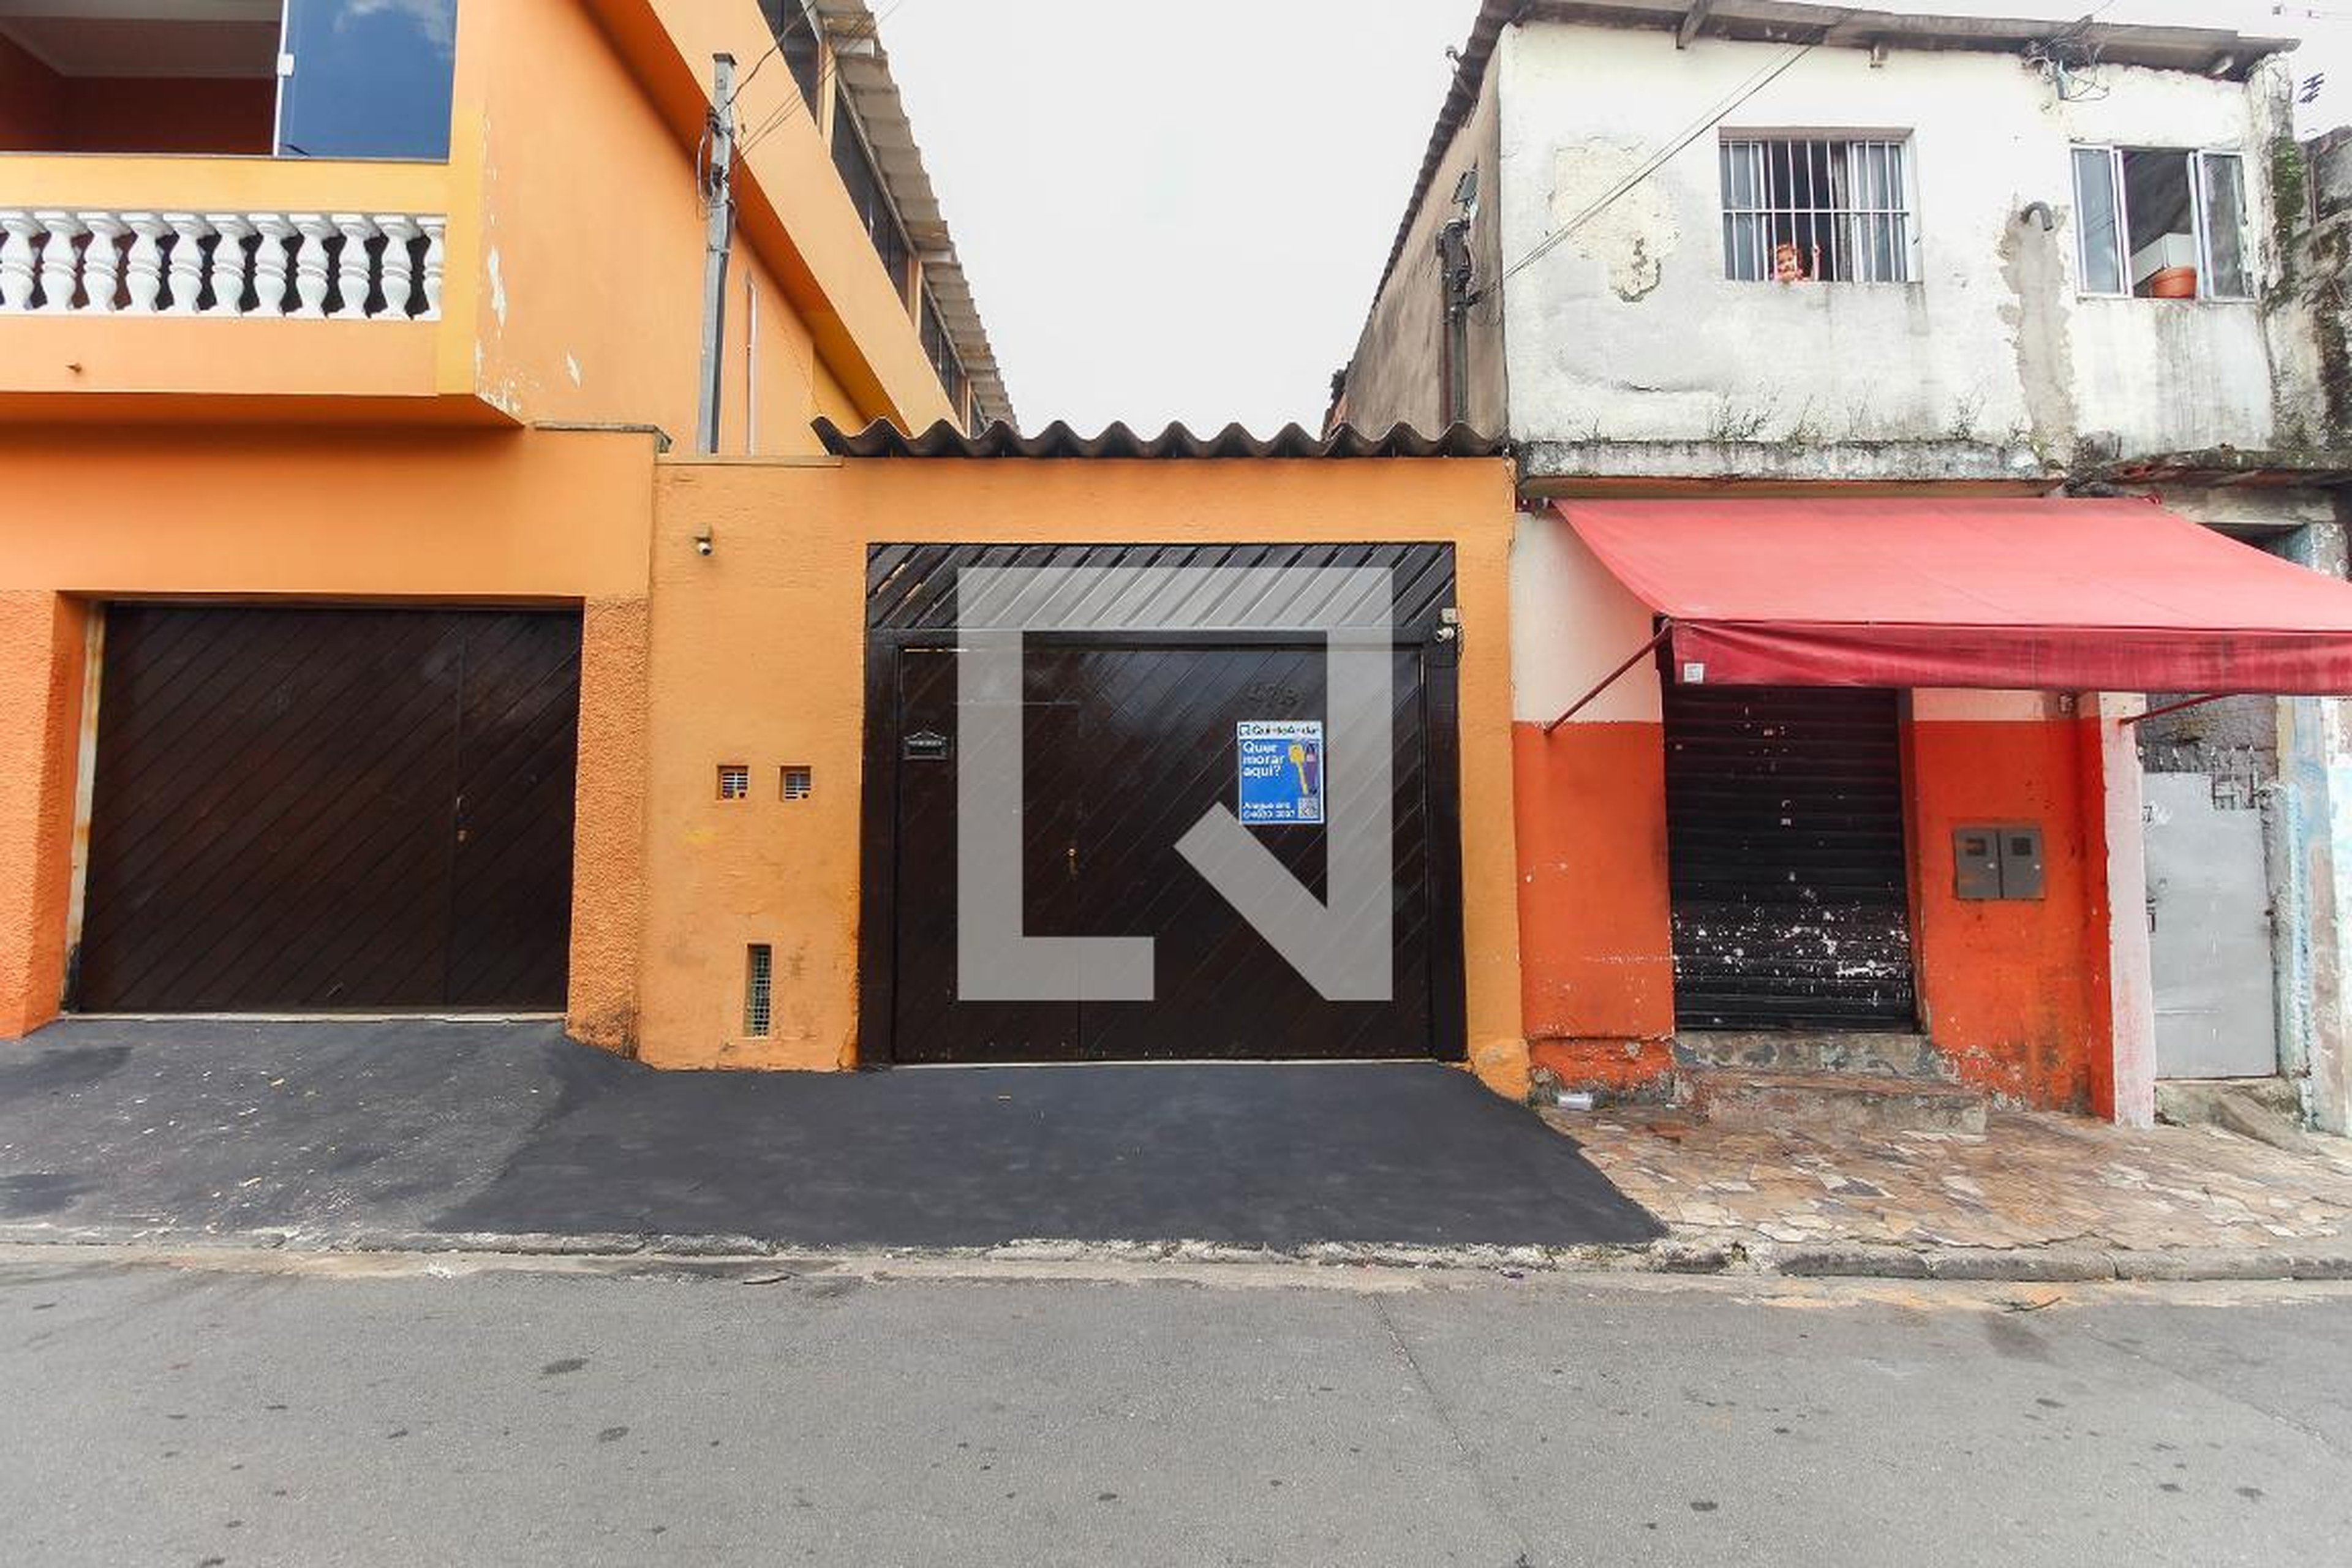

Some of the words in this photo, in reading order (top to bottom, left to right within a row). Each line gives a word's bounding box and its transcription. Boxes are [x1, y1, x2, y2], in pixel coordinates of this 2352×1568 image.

[1243, 741, 1278, 754] Quer
[1243, 754, 1284, 764] morar
[1243, 765, 1281, 777] aqui?
